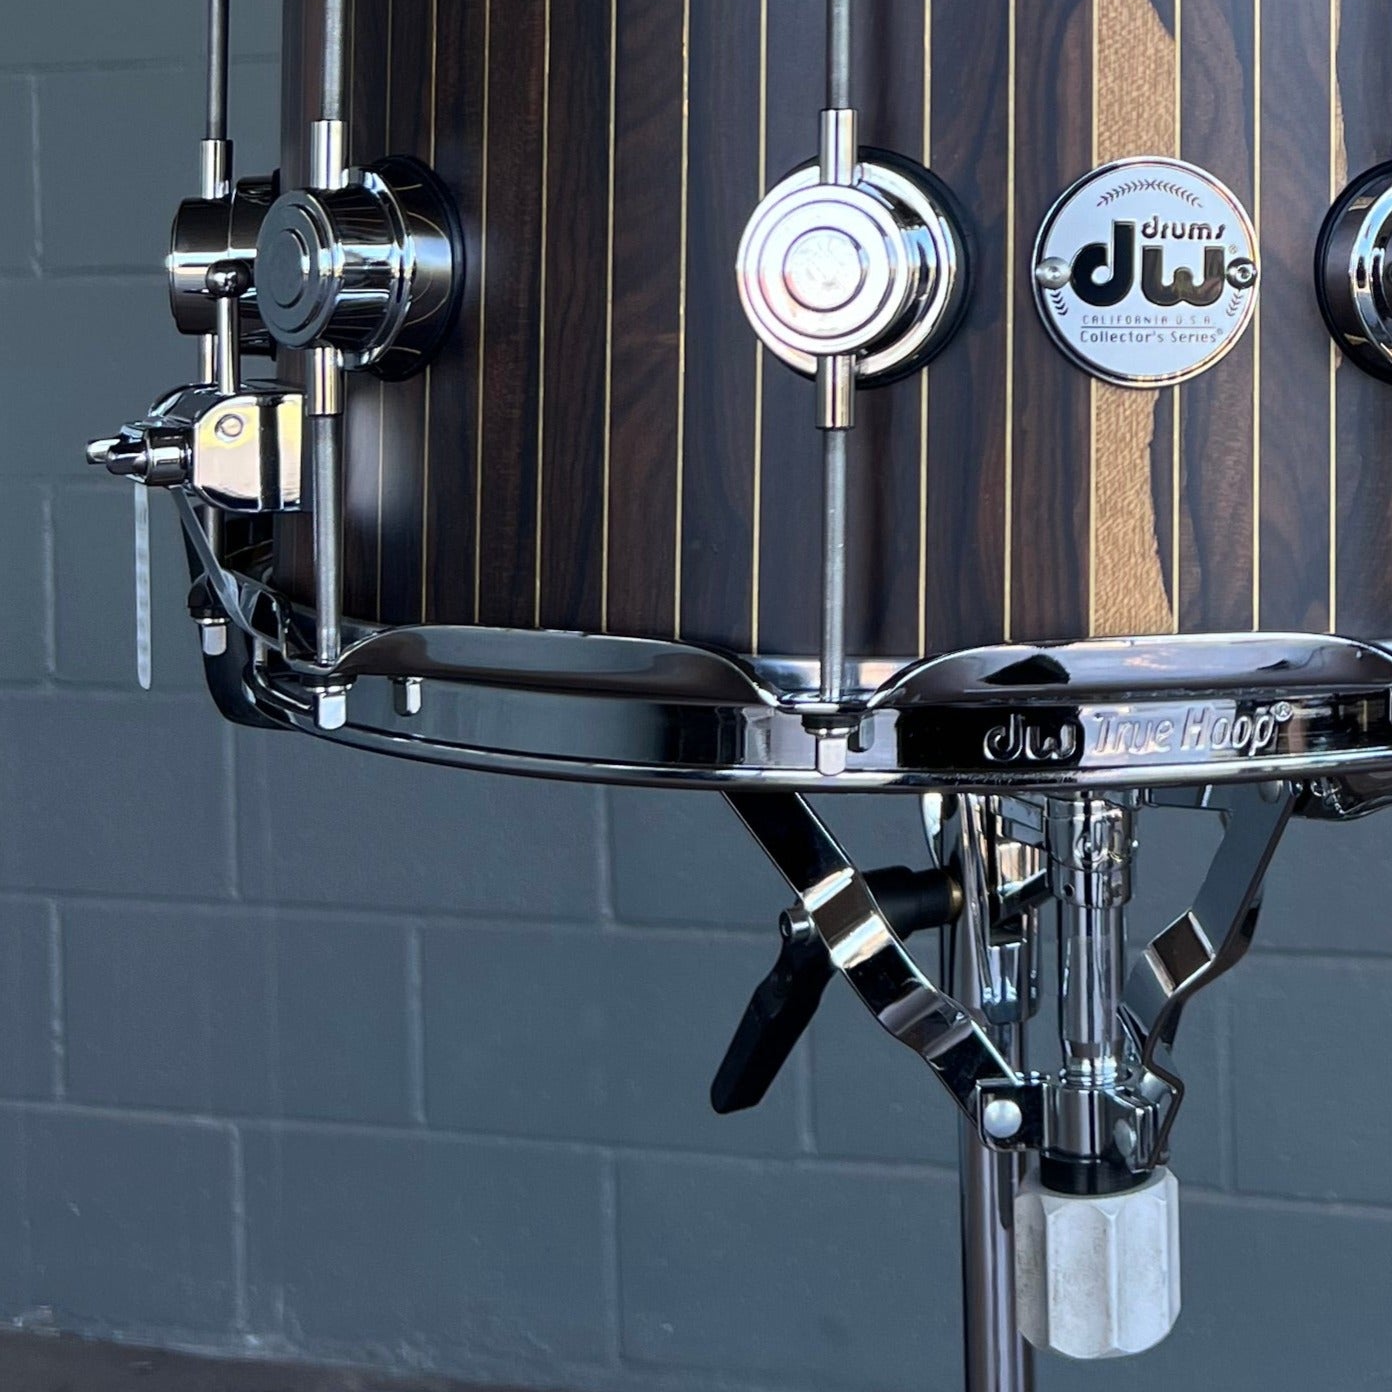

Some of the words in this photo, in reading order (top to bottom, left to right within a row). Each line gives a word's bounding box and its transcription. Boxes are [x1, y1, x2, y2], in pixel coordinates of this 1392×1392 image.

[1141, 216, 1226, 240] drums
[1069, 221, 1225, 307] dw
[1082, 315, 1168, 325] CALIFORNIA
[1080, 330, 1165, 343] Collector's
[1092, 708, 1174, 755] True
